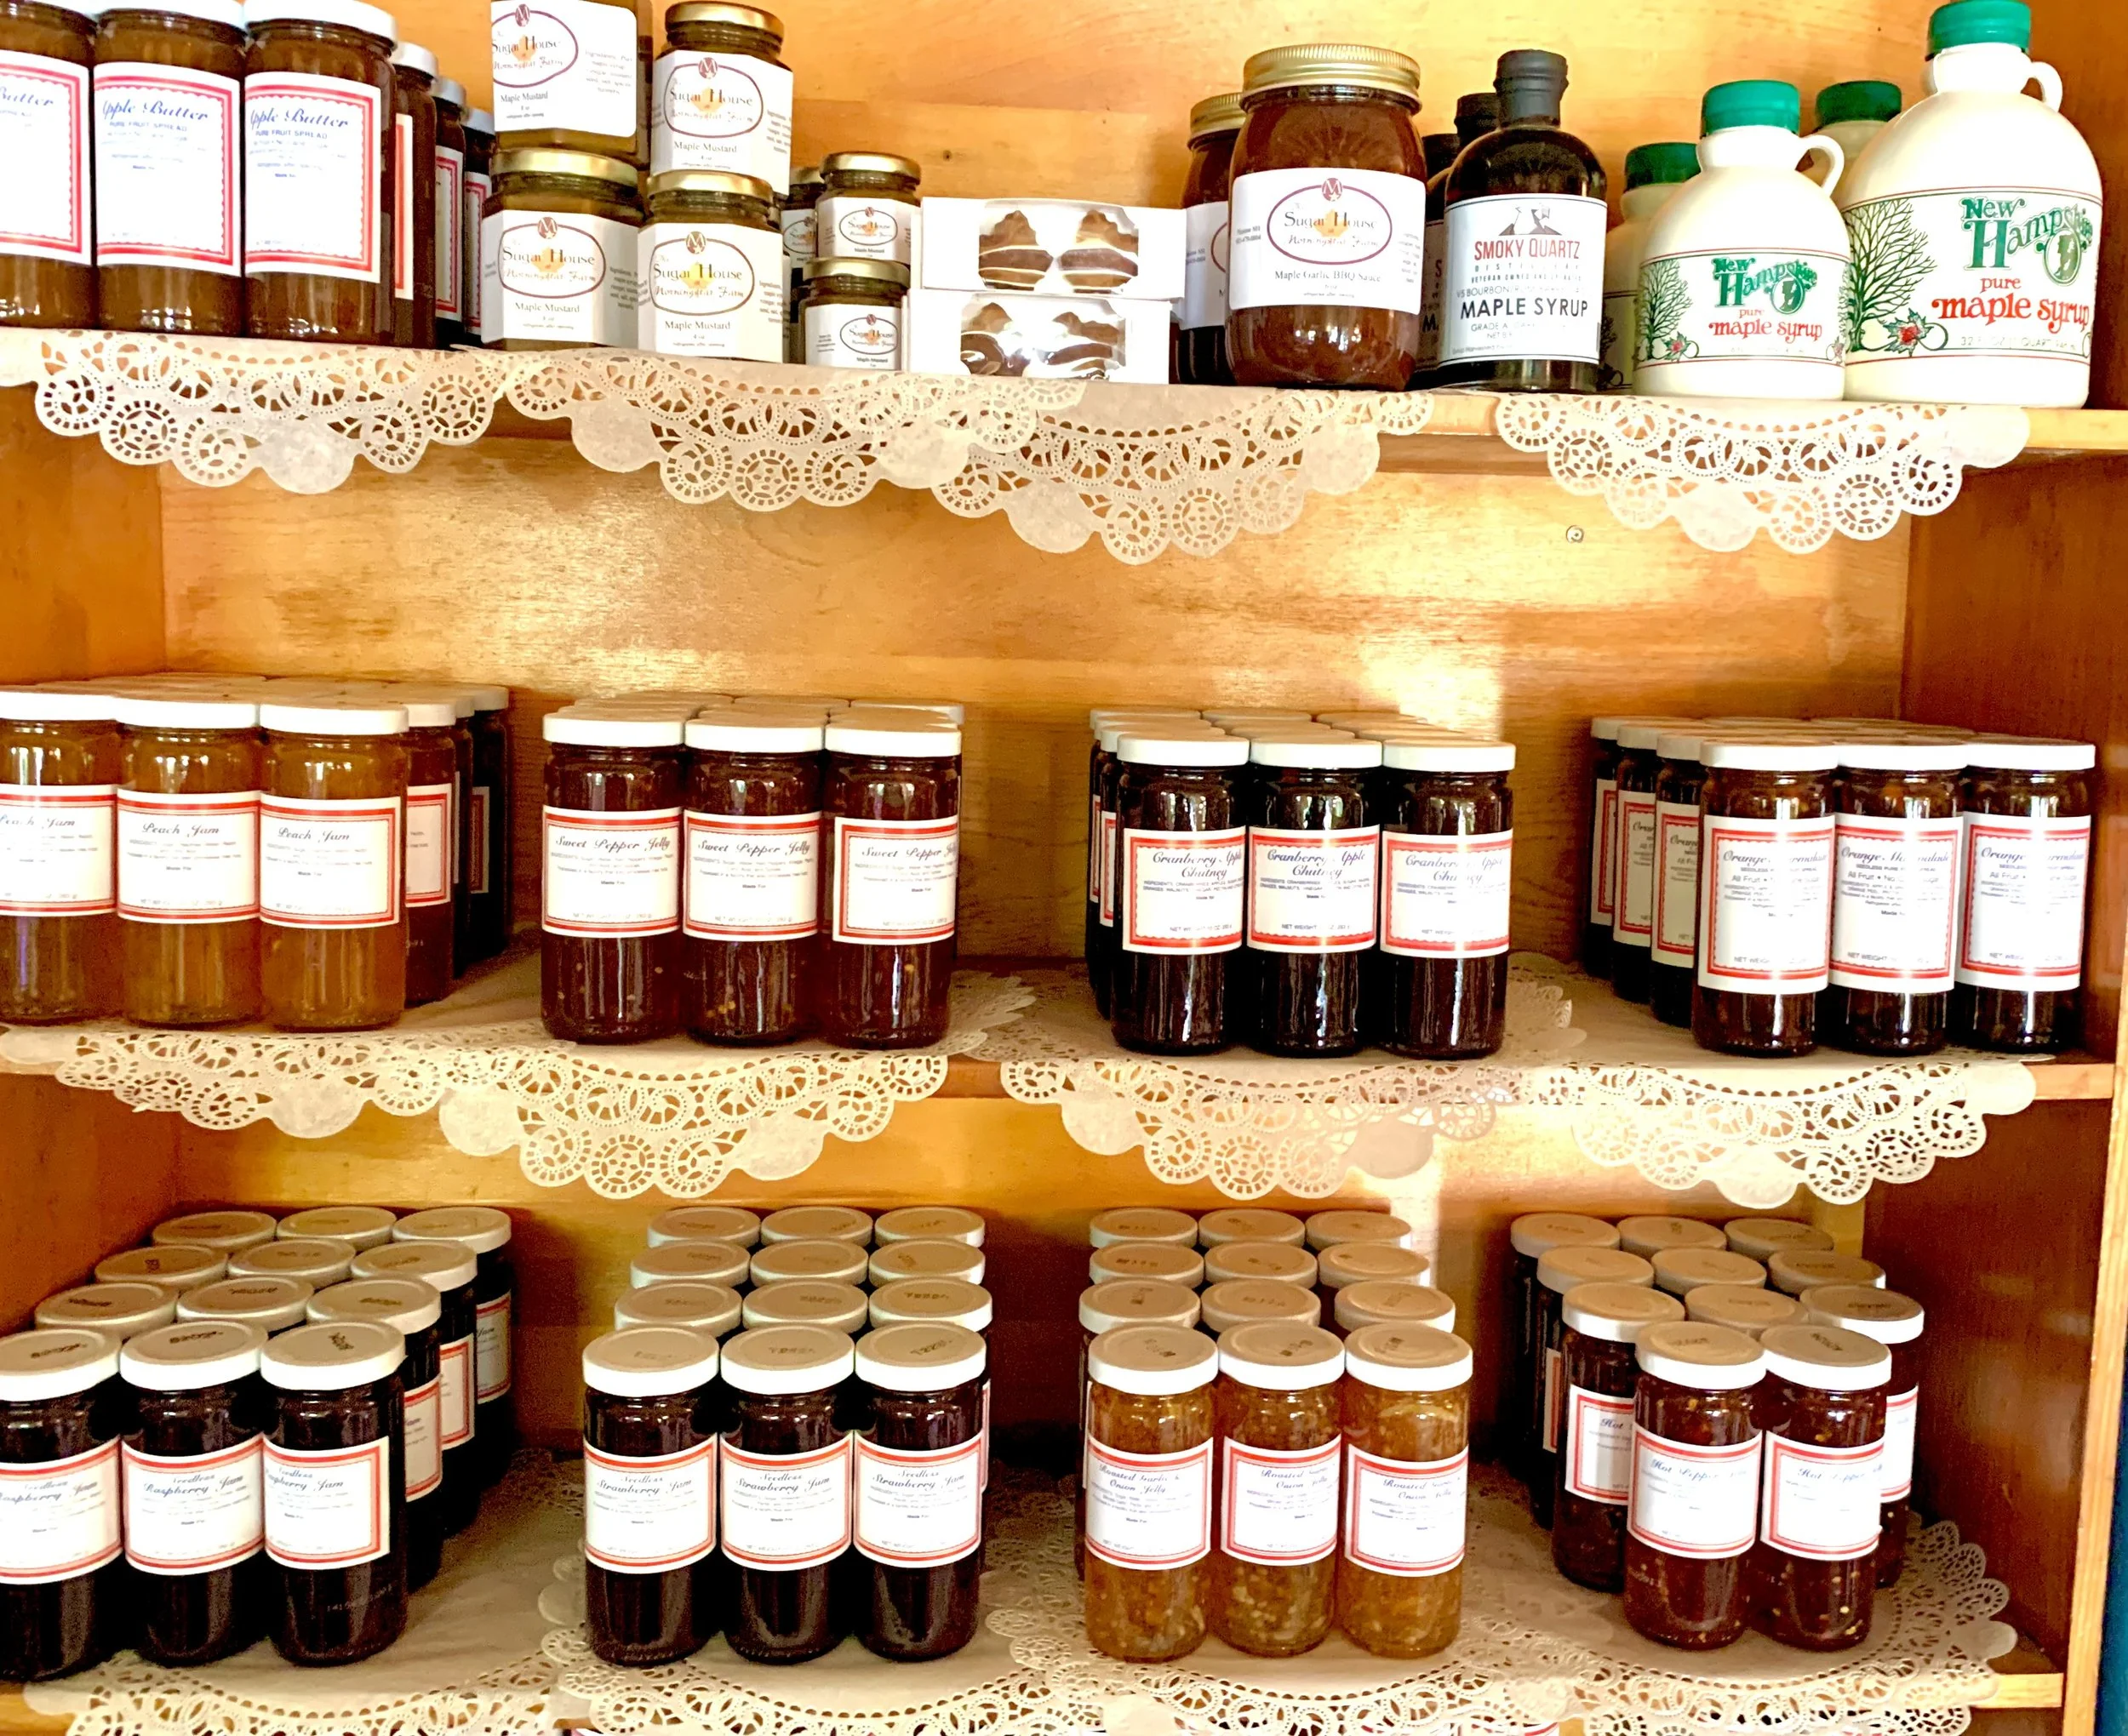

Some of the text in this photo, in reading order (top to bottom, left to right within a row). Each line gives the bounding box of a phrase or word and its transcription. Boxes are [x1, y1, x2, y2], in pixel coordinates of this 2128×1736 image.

[524, 36, 561, 50] House
[501, 90, 549, 103] Maple Mustard
[670, 88, 753, 106] Sugar House
[143, 100, 209, 120] Butter
[284, 108, 348, 128] Butter
[295, 130, 328, 140] SPREAD
[673, 141, 738, 153] Maple Mustard
[1959, 197, 2026, 220] New
[1284, 211, 1378, 229] Sugar House
[502, 246, 596, 266] Sugar House
[1474, 237, 1581, 261] SMOKY QUARTZ
[654, 263, 743, 282] Sugar House
[1711, 257, 1756, 274] New
[1274, 270, 1381, 283] Maple Garlic BBQ Sauce
[1471, 274, 1502, 284] VETERAN
[1713, 259, 1818, 308] Hampshire
[1466, 285, 1510, 298] BOURBON
[1980, 277, 2022, 294] pure
[515, 302, 581, 313] Maple Mustard
[1460, 298, 1588, 320] MAPLE SYRUP
[1739, 308, 1765, 319] pure
[1931, 293, 2090, 334] maple syrup
[665, 320, 731, 331] Maple Mustard
[1470, 322, 1500, 332] GRADE
[1708, 319, 1822, 344] maple syrup
[41, 817, 76, 830] Jam
[143, 822, 220, 838] Peach Jam
[1632, 821, 1654, 833] Oran
[277, 826, 351, 843] Peach Jam
[1669, 834, 1699, 849] Orang
[555, 835, 671, 854] Sweet Pepper Jelly
[698, 839, 810, 857] Sweet Pepper Jelly
[861, 846, 899, 858] Sweet
[906, 847, 942, 862] Pepper
[1152, 851, 1217, 868] Cranberry
[1267, 848, 1327, 867] Cranberry
[1405, 854, 1470, 869] Cranber
[1723, 849, 1767, 867] Orange
[1841, 846, 1949, 863] Orange Mamalade
[1981, 847, 2025, 864] Orange
[1181, 866, 1228, 881] Chutney
[1292, 864, 1343, 881] Chutney
[1433, 870, 1483, 885] Chuney
[1857, 871, 1874, 881] Fruit
[1861, 952, 1888, 962] WEIGHT
[1600, 1417, 1624, 1430] Hot
[898, 1470, 940, 1478] Seedless
[1098, 1464, 1137, 1482] Roasted
[1261, 1469, 1305, 1480] Roasted
[1650, 1459, 1673, 1474] Hot
[1798, 1467, 1822, 1481] Hot
[760, 1472, 803, 1482] Seedless
[872, 1473, 936, 1492] Strawberry
[1383, 1479, 1428, 1490] Roasted
[143, 1482, 210, 1499] Raspberry
[313, 1479, 345, 1492] Jam
[597, 1479, 661, 1497] Strawberry
[736, 1477, 831, 1494] Strawberry Jam
[1109, 1479, 1136, 1492] Onion
